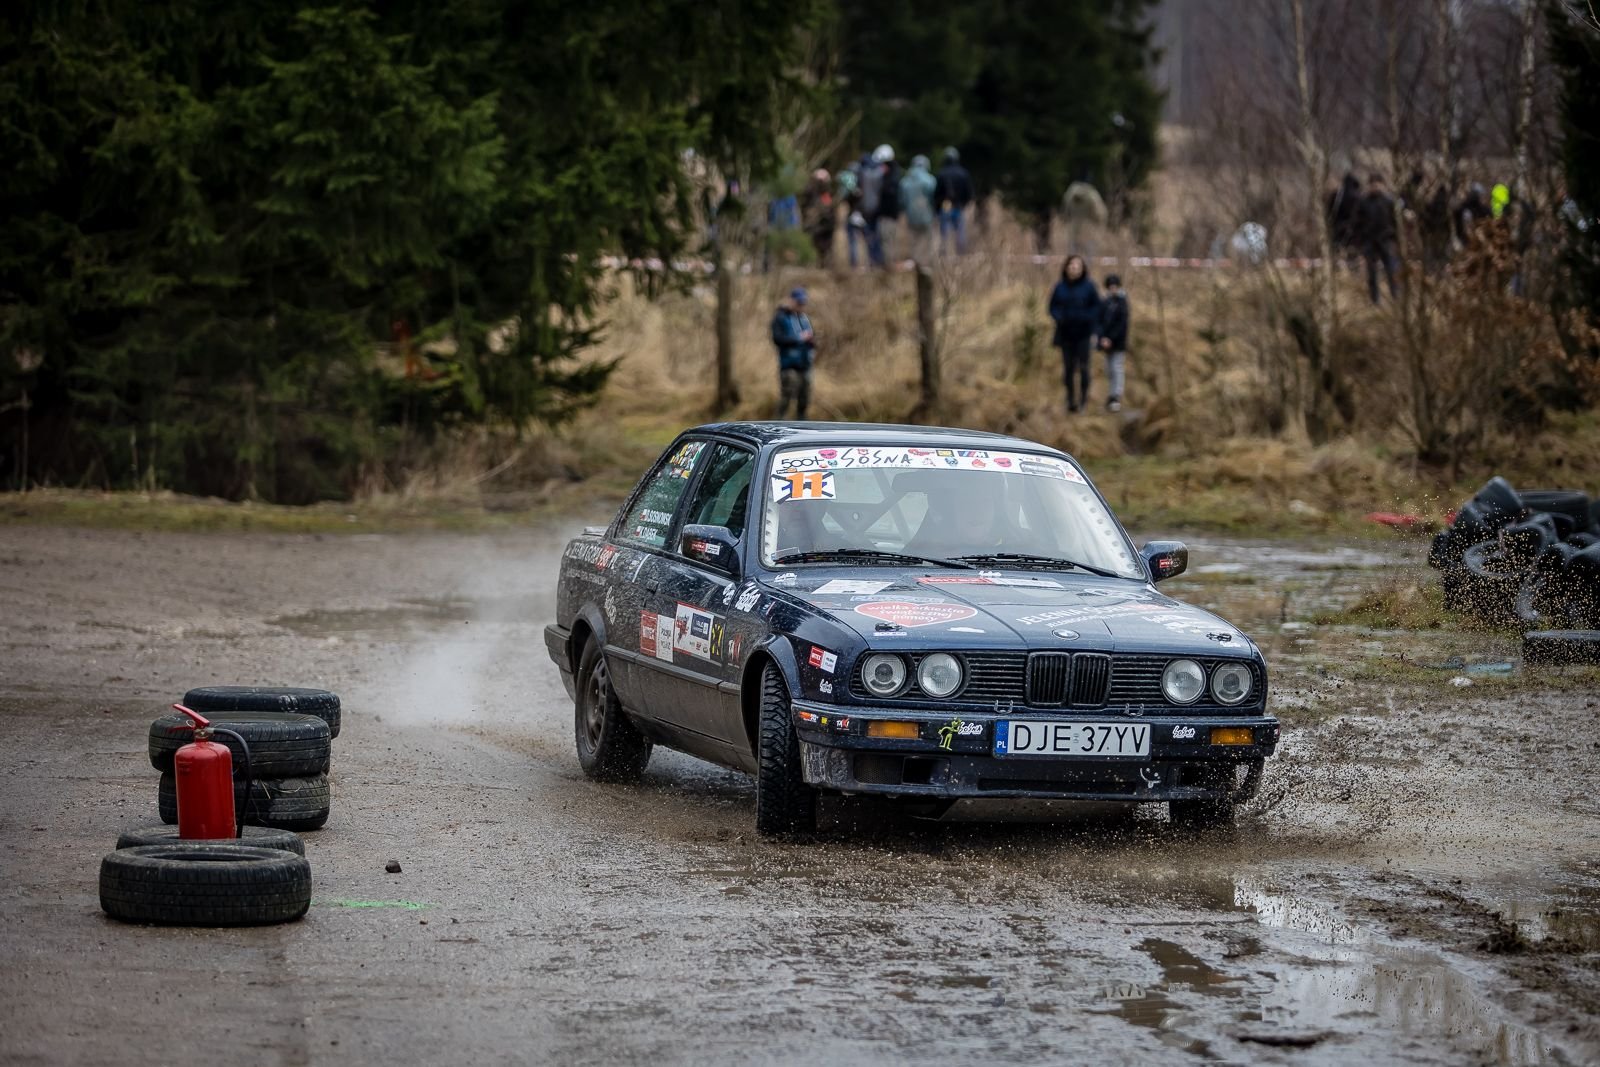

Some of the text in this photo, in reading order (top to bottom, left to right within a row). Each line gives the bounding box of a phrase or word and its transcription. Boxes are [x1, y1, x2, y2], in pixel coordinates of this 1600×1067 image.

[785, 472, 823, 498] 11
[996, 740, 1007, 749] PL
[1013, 724, 1146, 753] DJE 37YV
